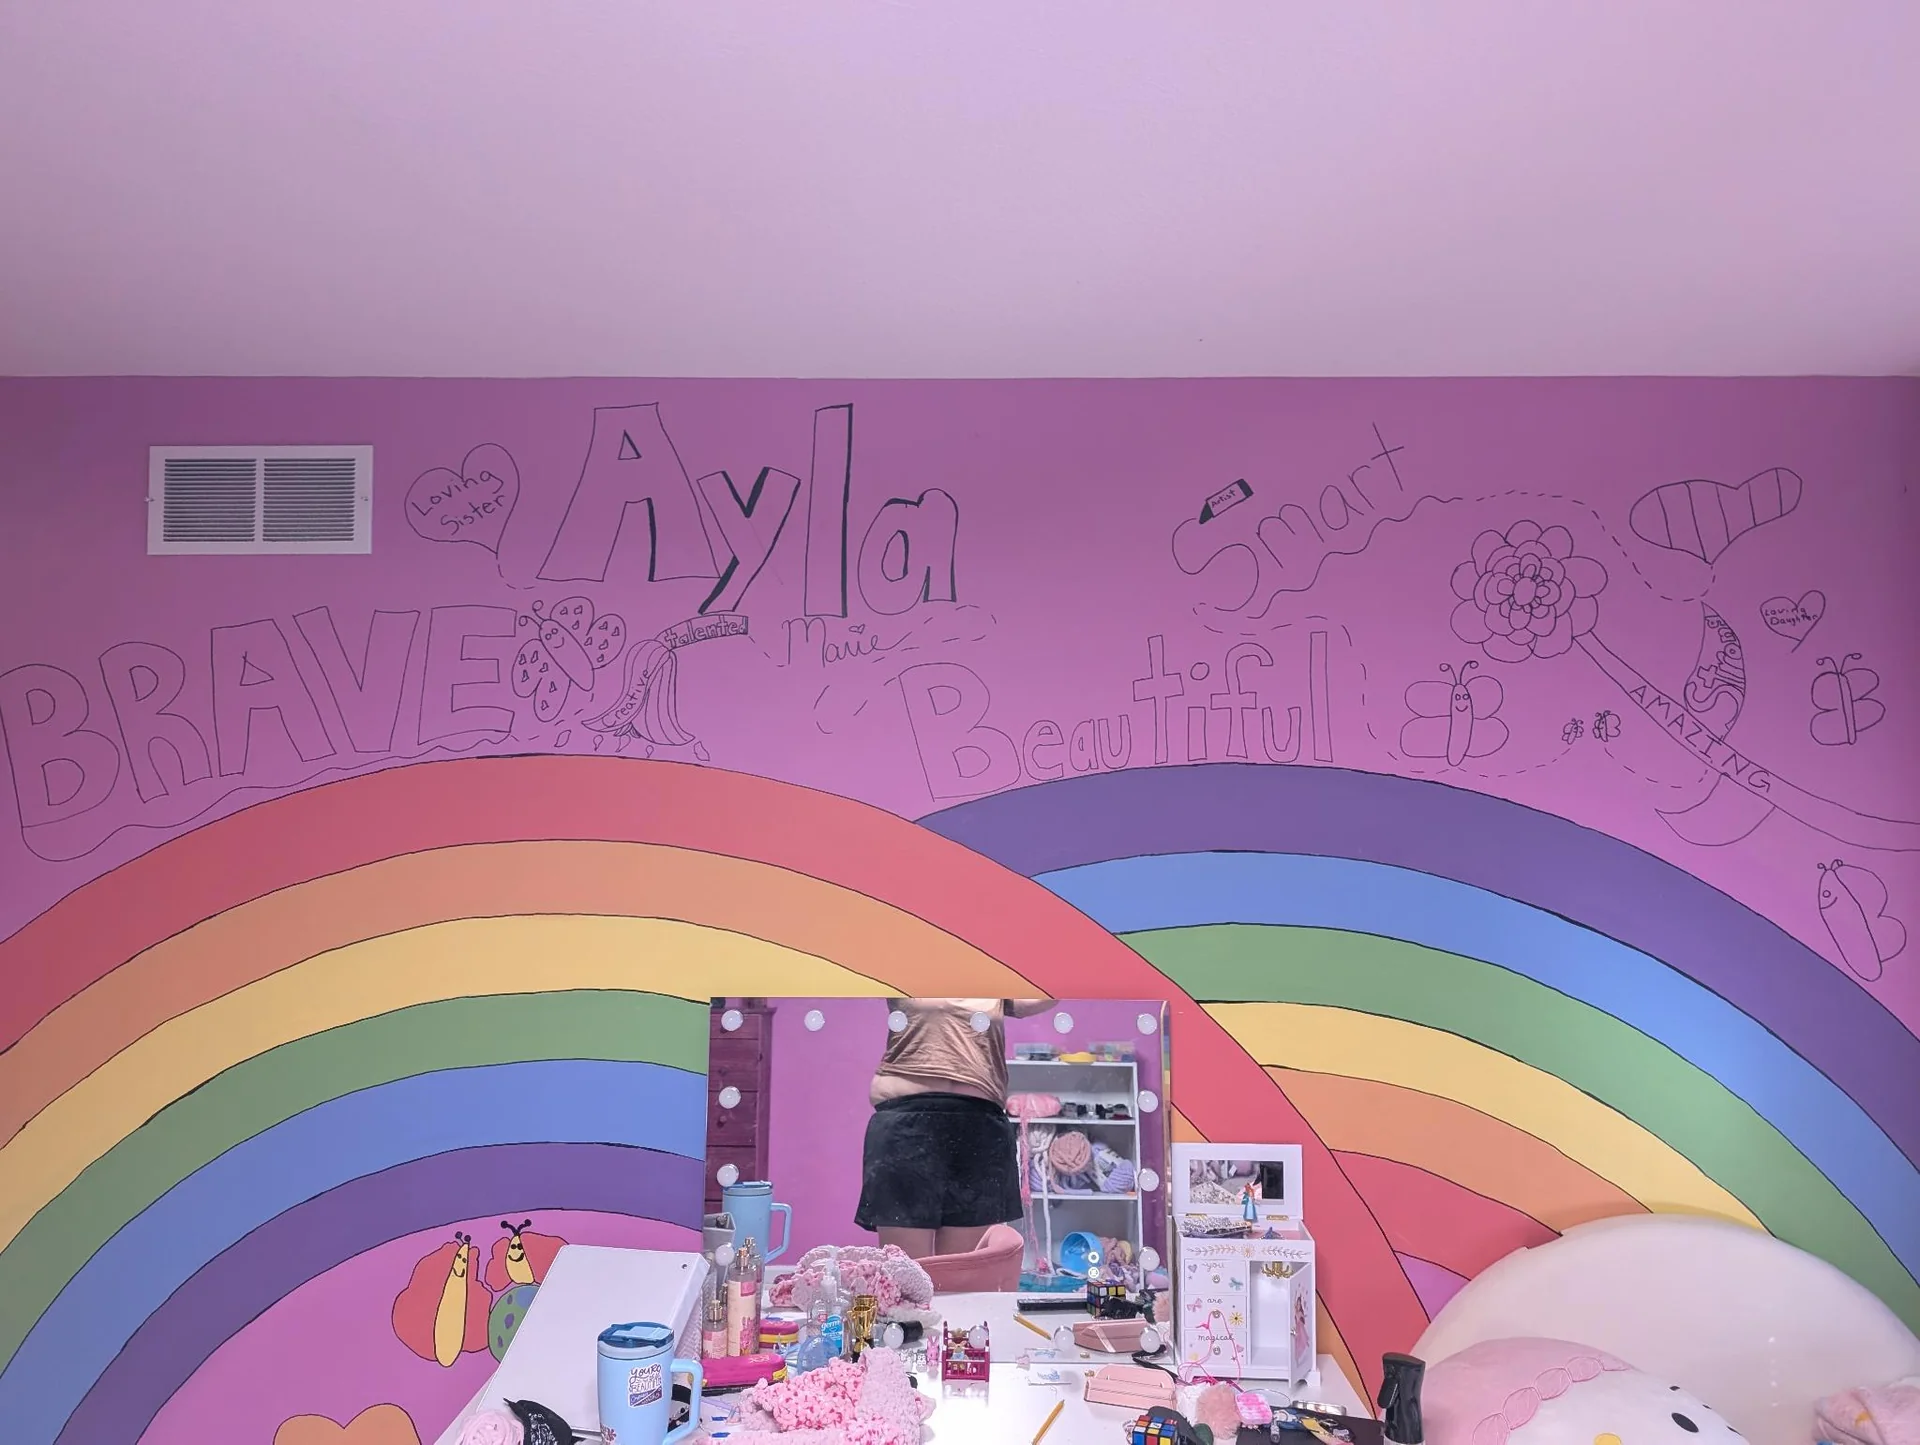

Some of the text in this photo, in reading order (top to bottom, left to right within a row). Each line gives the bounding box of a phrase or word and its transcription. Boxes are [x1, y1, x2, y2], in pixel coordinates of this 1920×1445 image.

[411, 470, 504, 516] Loving
[440, 494, 505, 536] Sister
[536, 402, 958, 617] Ayla
[1171, 421, 1404, 612] Smart
[1211, 489, 1236, 508] Artist
[664, 614, 749, 650] talented
[781, 617, 912, 668] Marie
[0, 604, 518, 828] BRAVE
[898, 631, 1334, 802] Beautiful
[1629, 683, 1772, 792] AMAZING
[1202, 1261, 1225, 1273] you
[1197, 1333, 1235, 1344] magical
